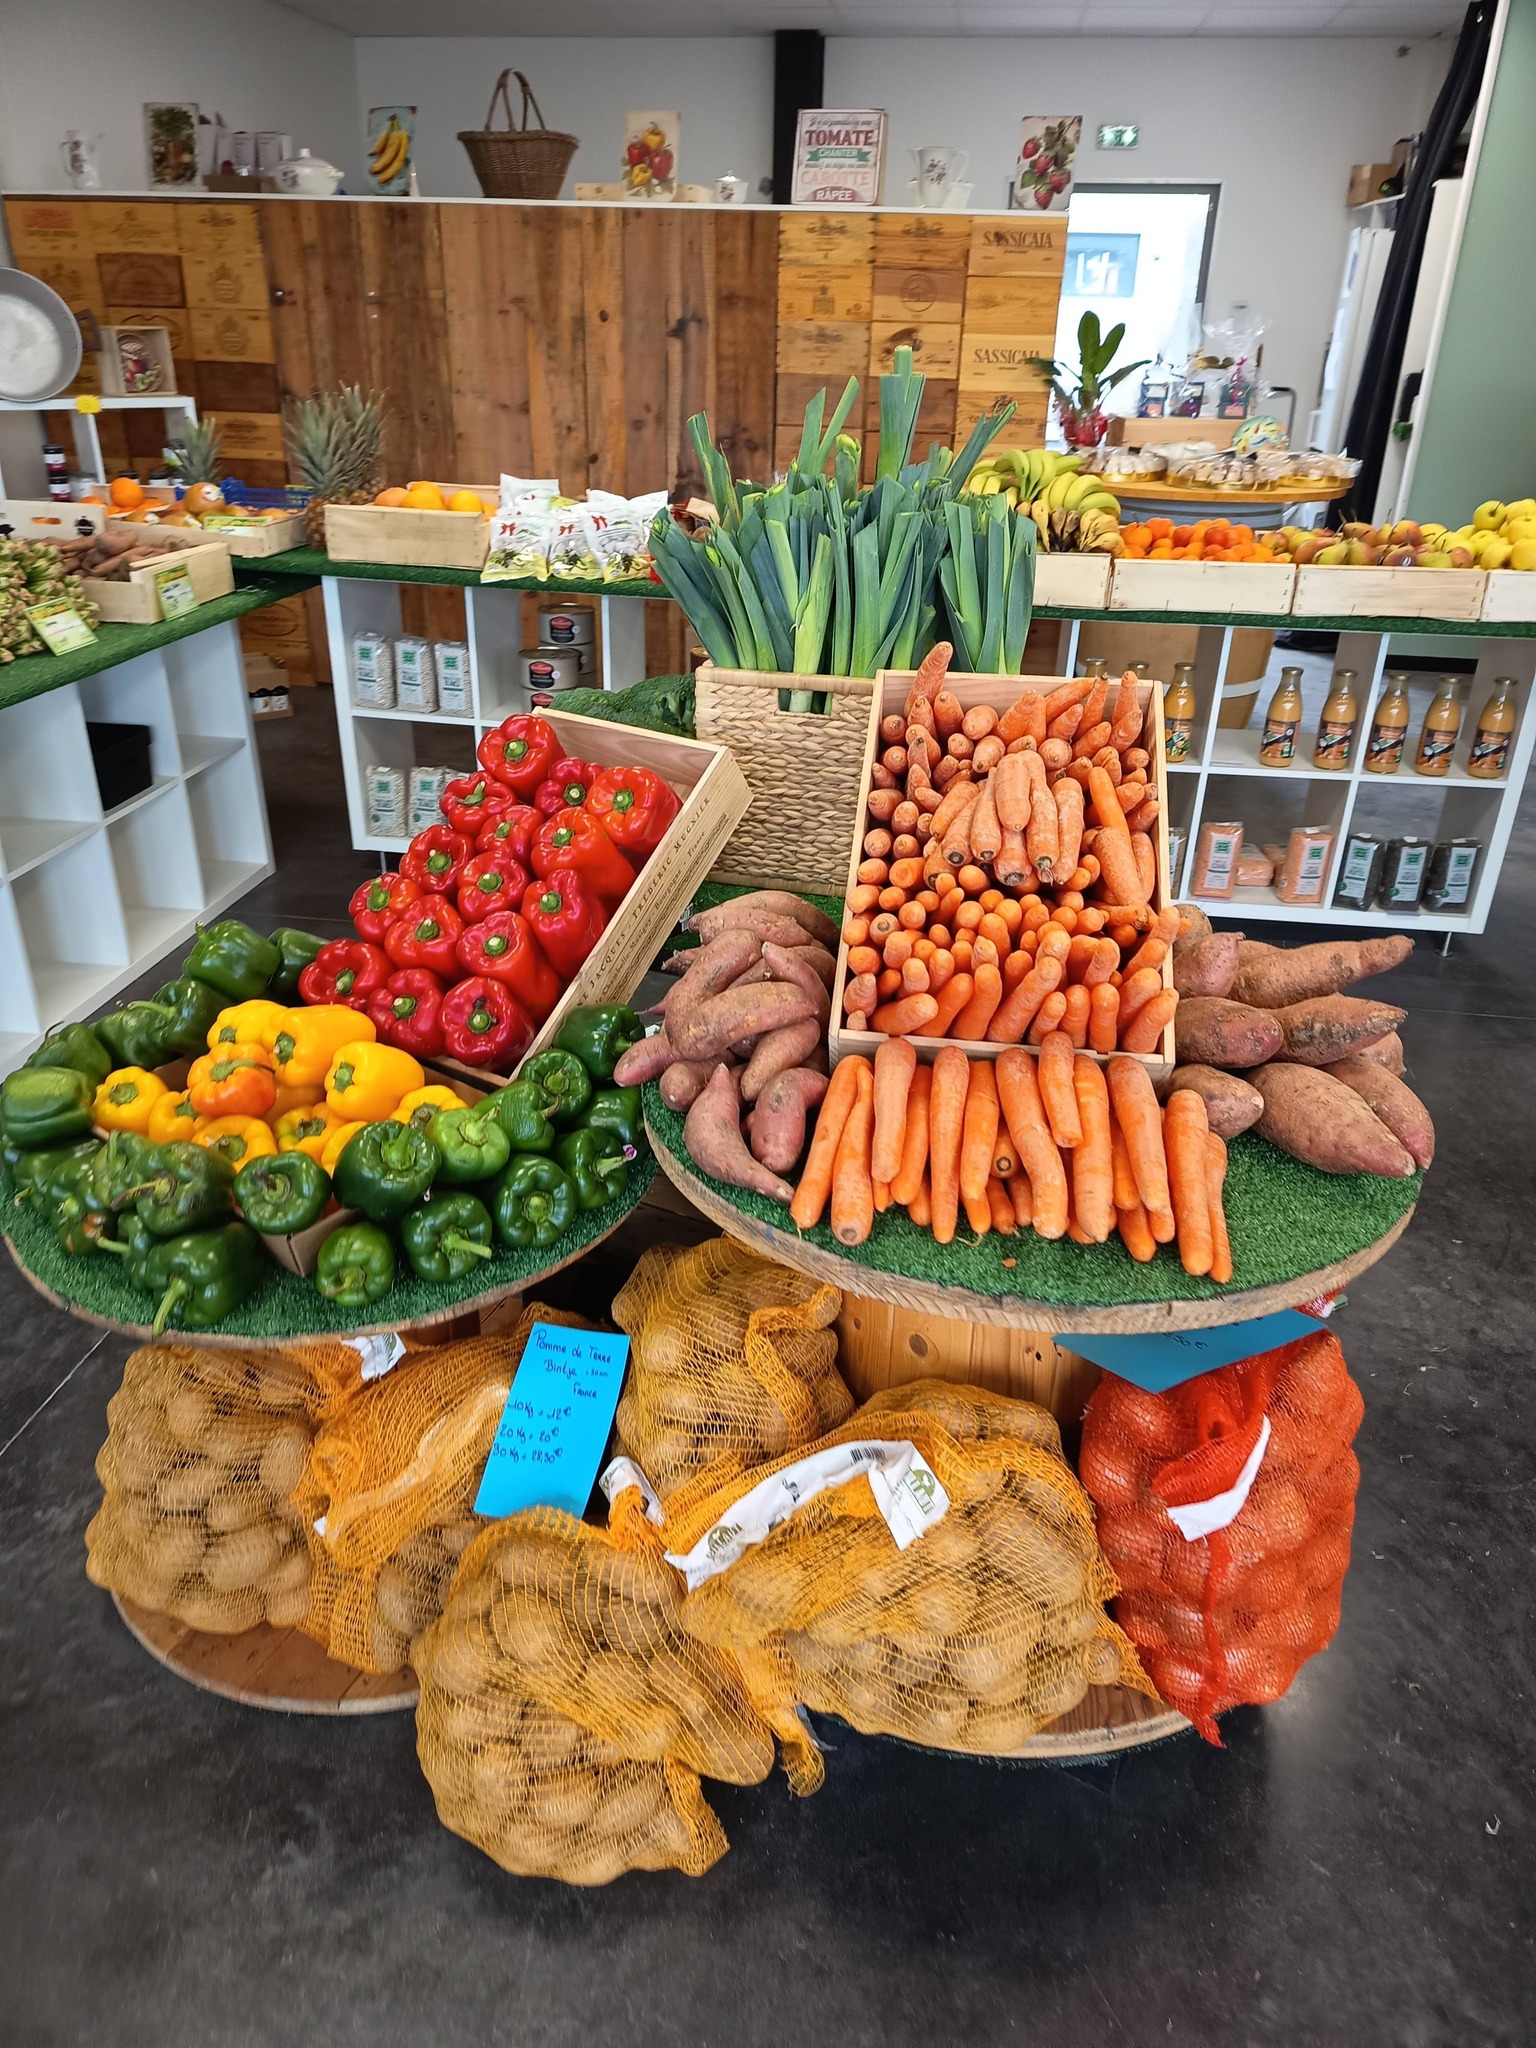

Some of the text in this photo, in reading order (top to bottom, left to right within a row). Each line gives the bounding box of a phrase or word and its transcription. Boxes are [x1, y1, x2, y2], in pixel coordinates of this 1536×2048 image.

[805, 129, 874, 146] TOMATE
[818, 148, 858, 157] CHANTER
[801, 171, 870, 186] CAROTTE
[654, 869, 683, 910] Bourgogne
[687, 830, 707, 858] France
[589, 931, 628, 988] JACQUES
[631, 856, 673, 920] FRÉDÉRIC
[673, 797, 711, 854] MUGNIER
[533, 1329, 567, 1353] Pomme
[571, 1343, 582, 1358] de
[544, 1359, 577, 1380] Bintje
